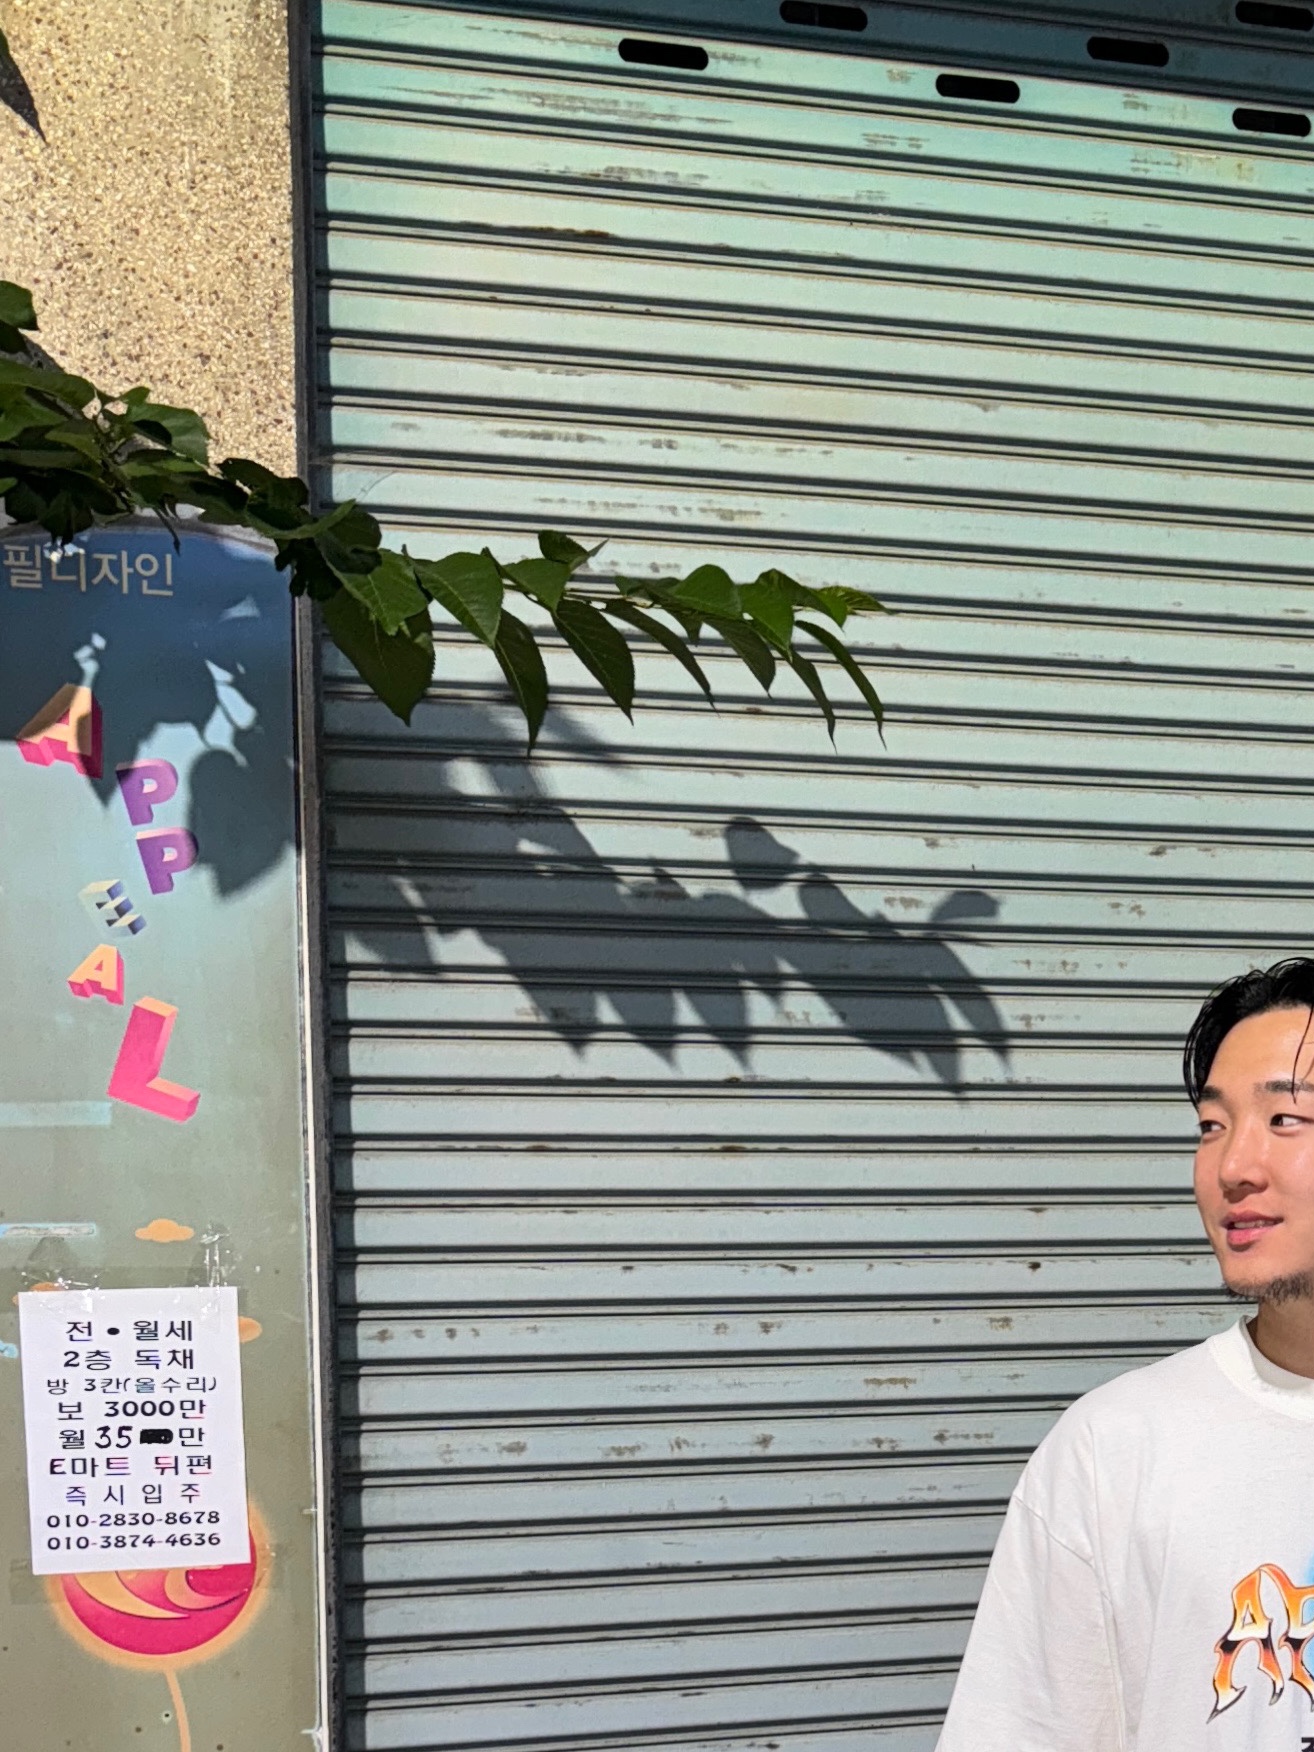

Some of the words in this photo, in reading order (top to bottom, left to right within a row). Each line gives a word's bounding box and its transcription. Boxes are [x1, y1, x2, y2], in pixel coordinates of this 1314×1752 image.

[3, 544, 173, 596] 필디자인
[63, 1350, 112, 1370] 2층
[47, 1378, 69, 1396] 방
[57, 1401, 84, 1420] 보
[104, 1399, 206, 1419] 3000만
[58, 1429, 86, 1450] 월
[49, 1456, 131, 1478] E마트
[153, 1455, 212, 1476] 뒤편
[46, 1511, 220, 1528] 010-2830-8678
[47, 1533, 221, 1550] 010-3874-4636
